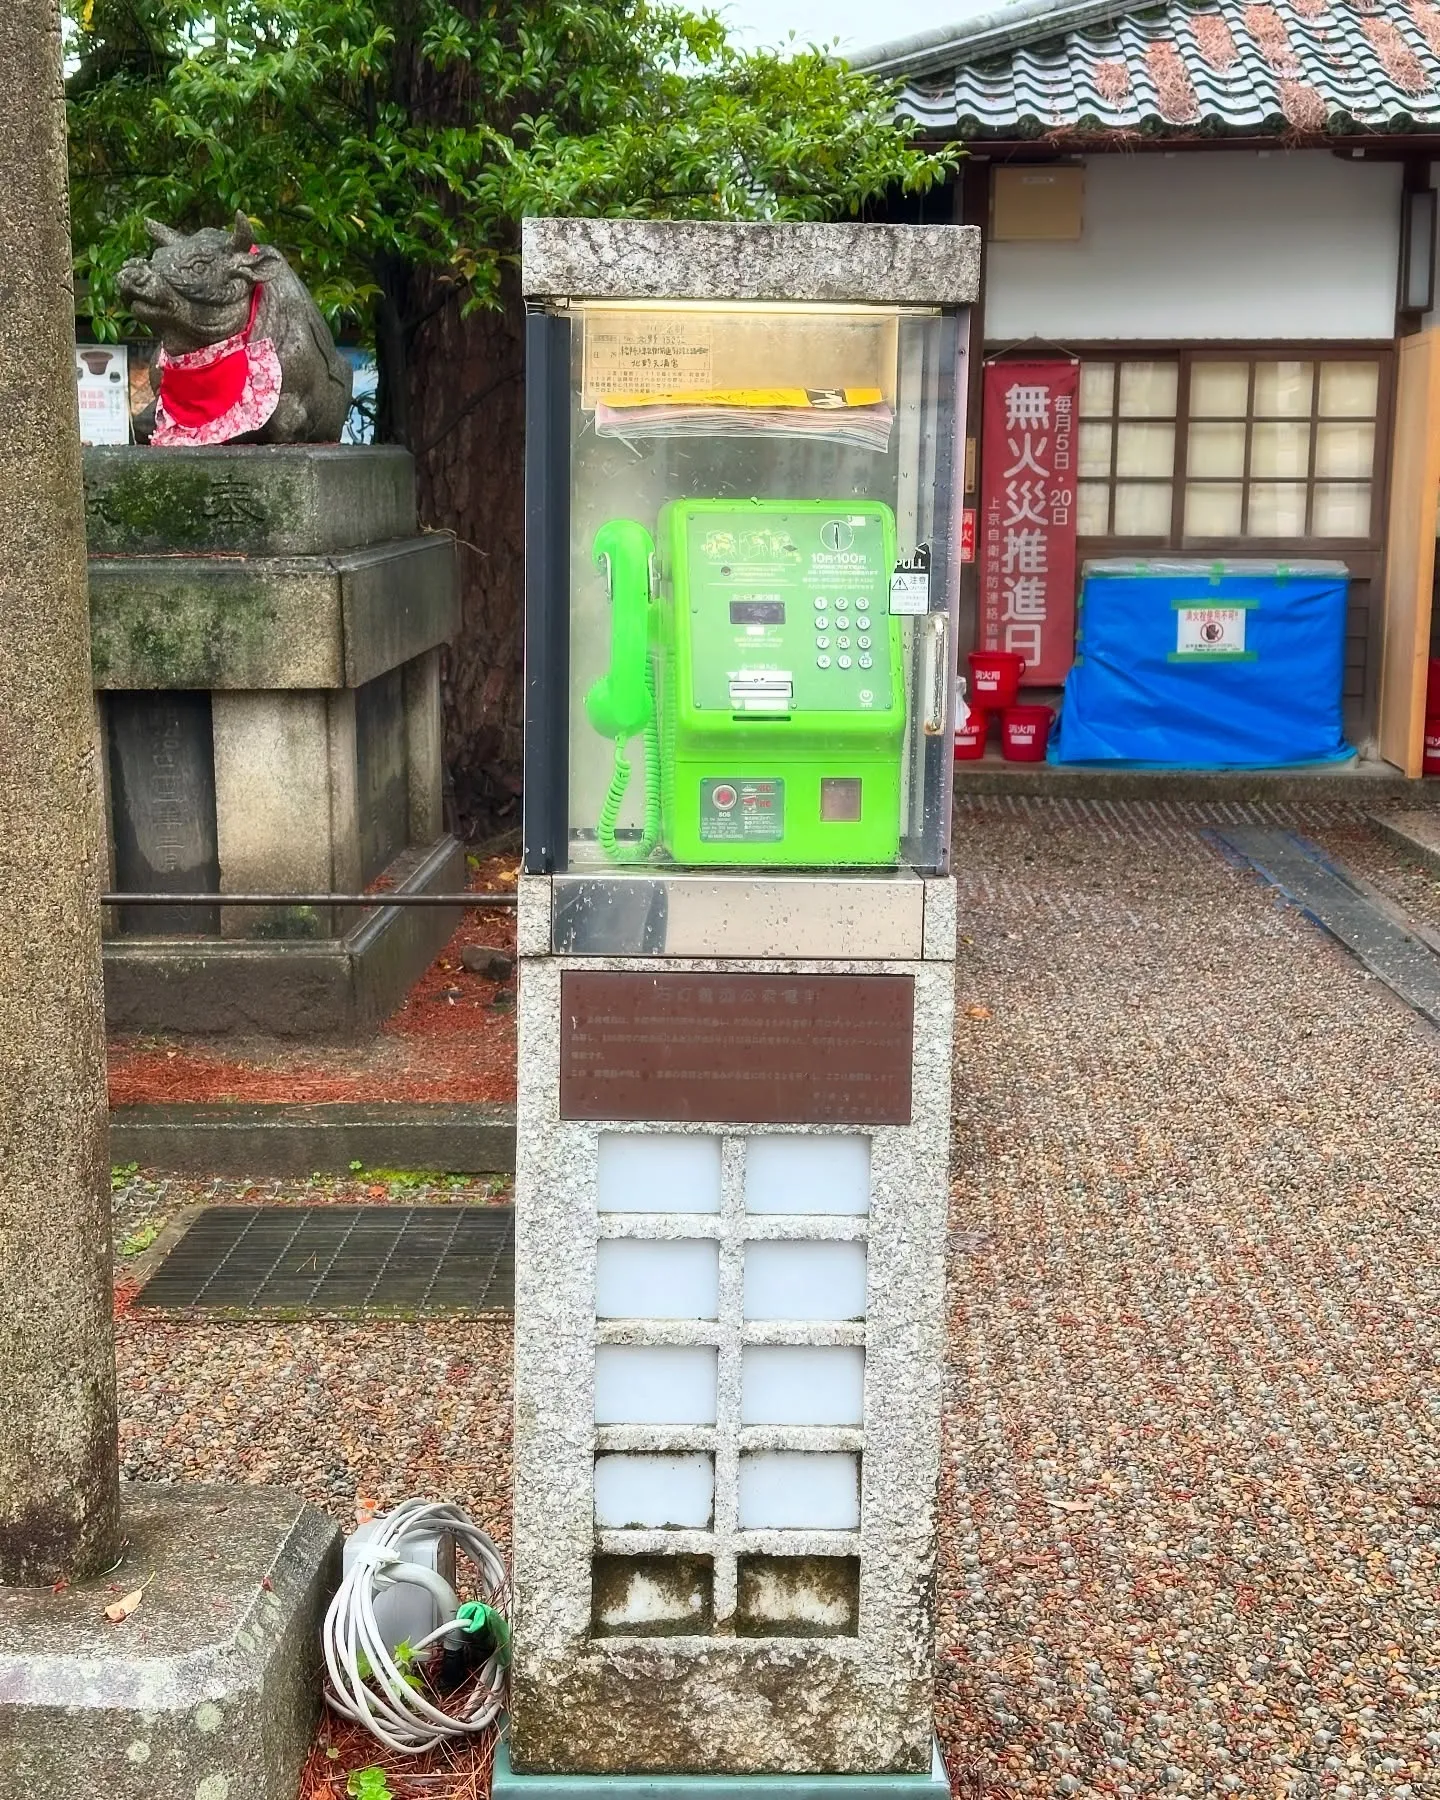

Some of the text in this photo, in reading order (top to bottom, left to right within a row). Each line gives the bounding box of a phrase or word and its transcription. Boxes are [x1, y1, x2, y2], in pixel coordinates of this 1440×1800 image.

[1001, 383, 1050, 667] 無火災推進日
[895, 558, 926, 570] PULL
[909, 576, 927, 585] 注意
[975, 670, 1001, 681] 消火用
[1009, 724, 1036, 735] 消火用
